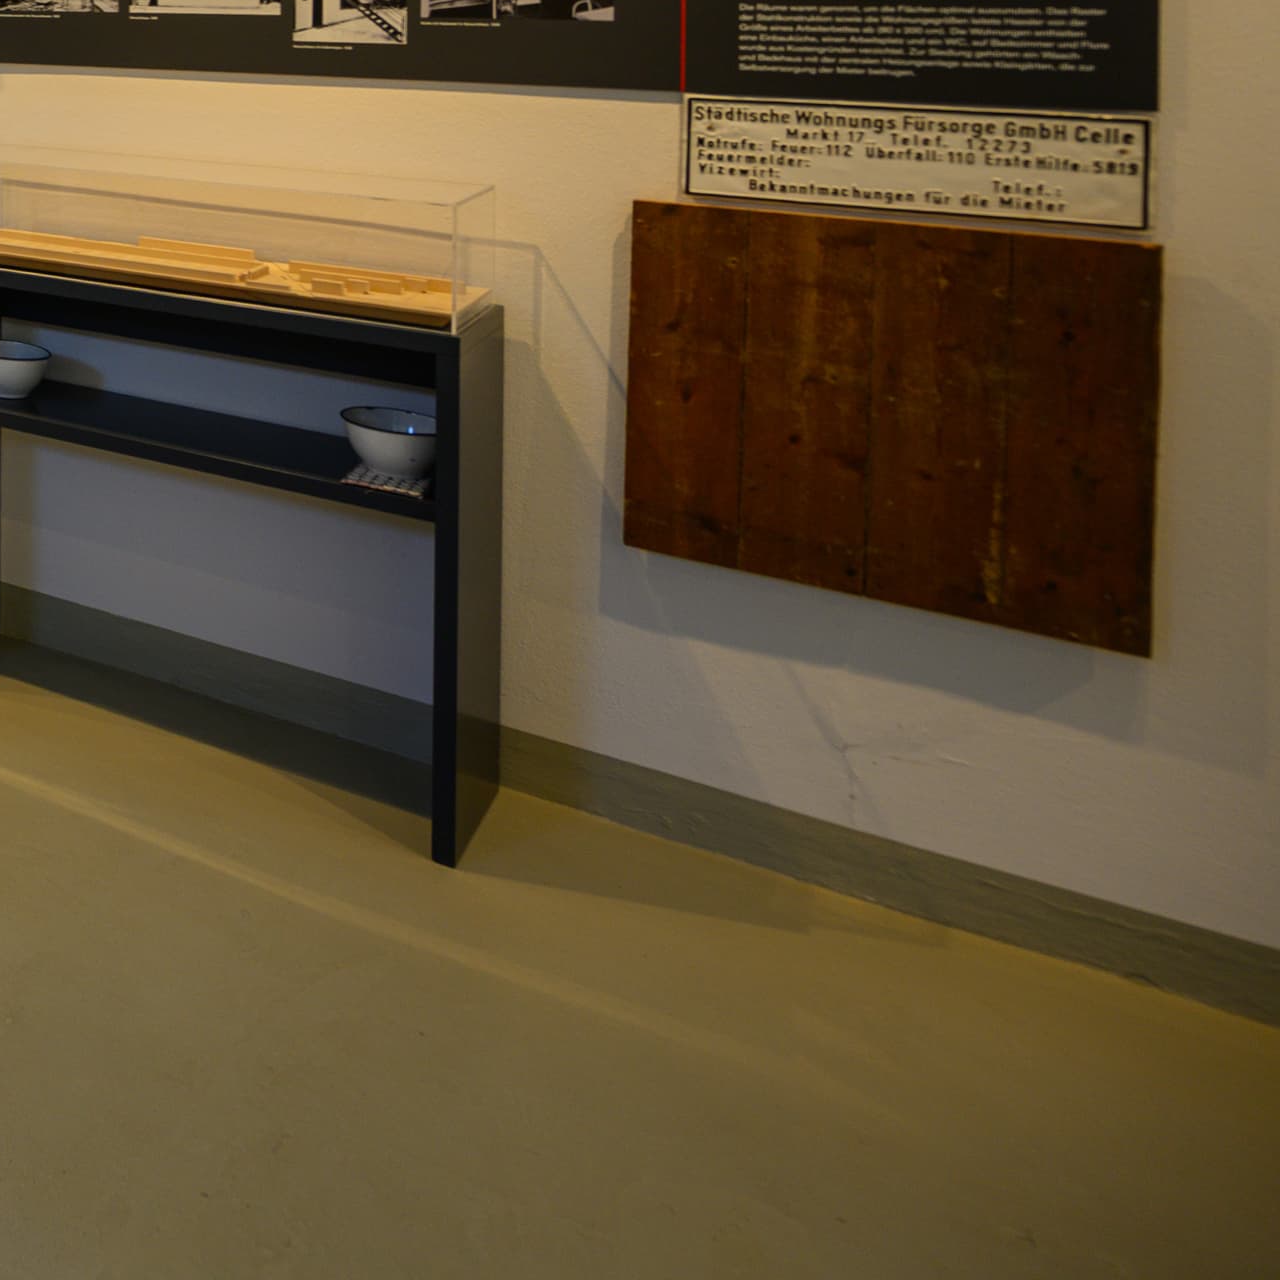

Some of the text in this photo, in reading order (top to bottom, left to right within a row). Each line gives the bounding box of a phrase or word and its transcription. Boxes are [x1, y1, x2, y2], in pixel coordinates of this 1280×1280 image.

[694, 106, 1136, 146] Städtische Wohnungs Fürsorge GmbH Celle
[748, 180, 1066, 213] Bekanntmachungen für die Mieter
